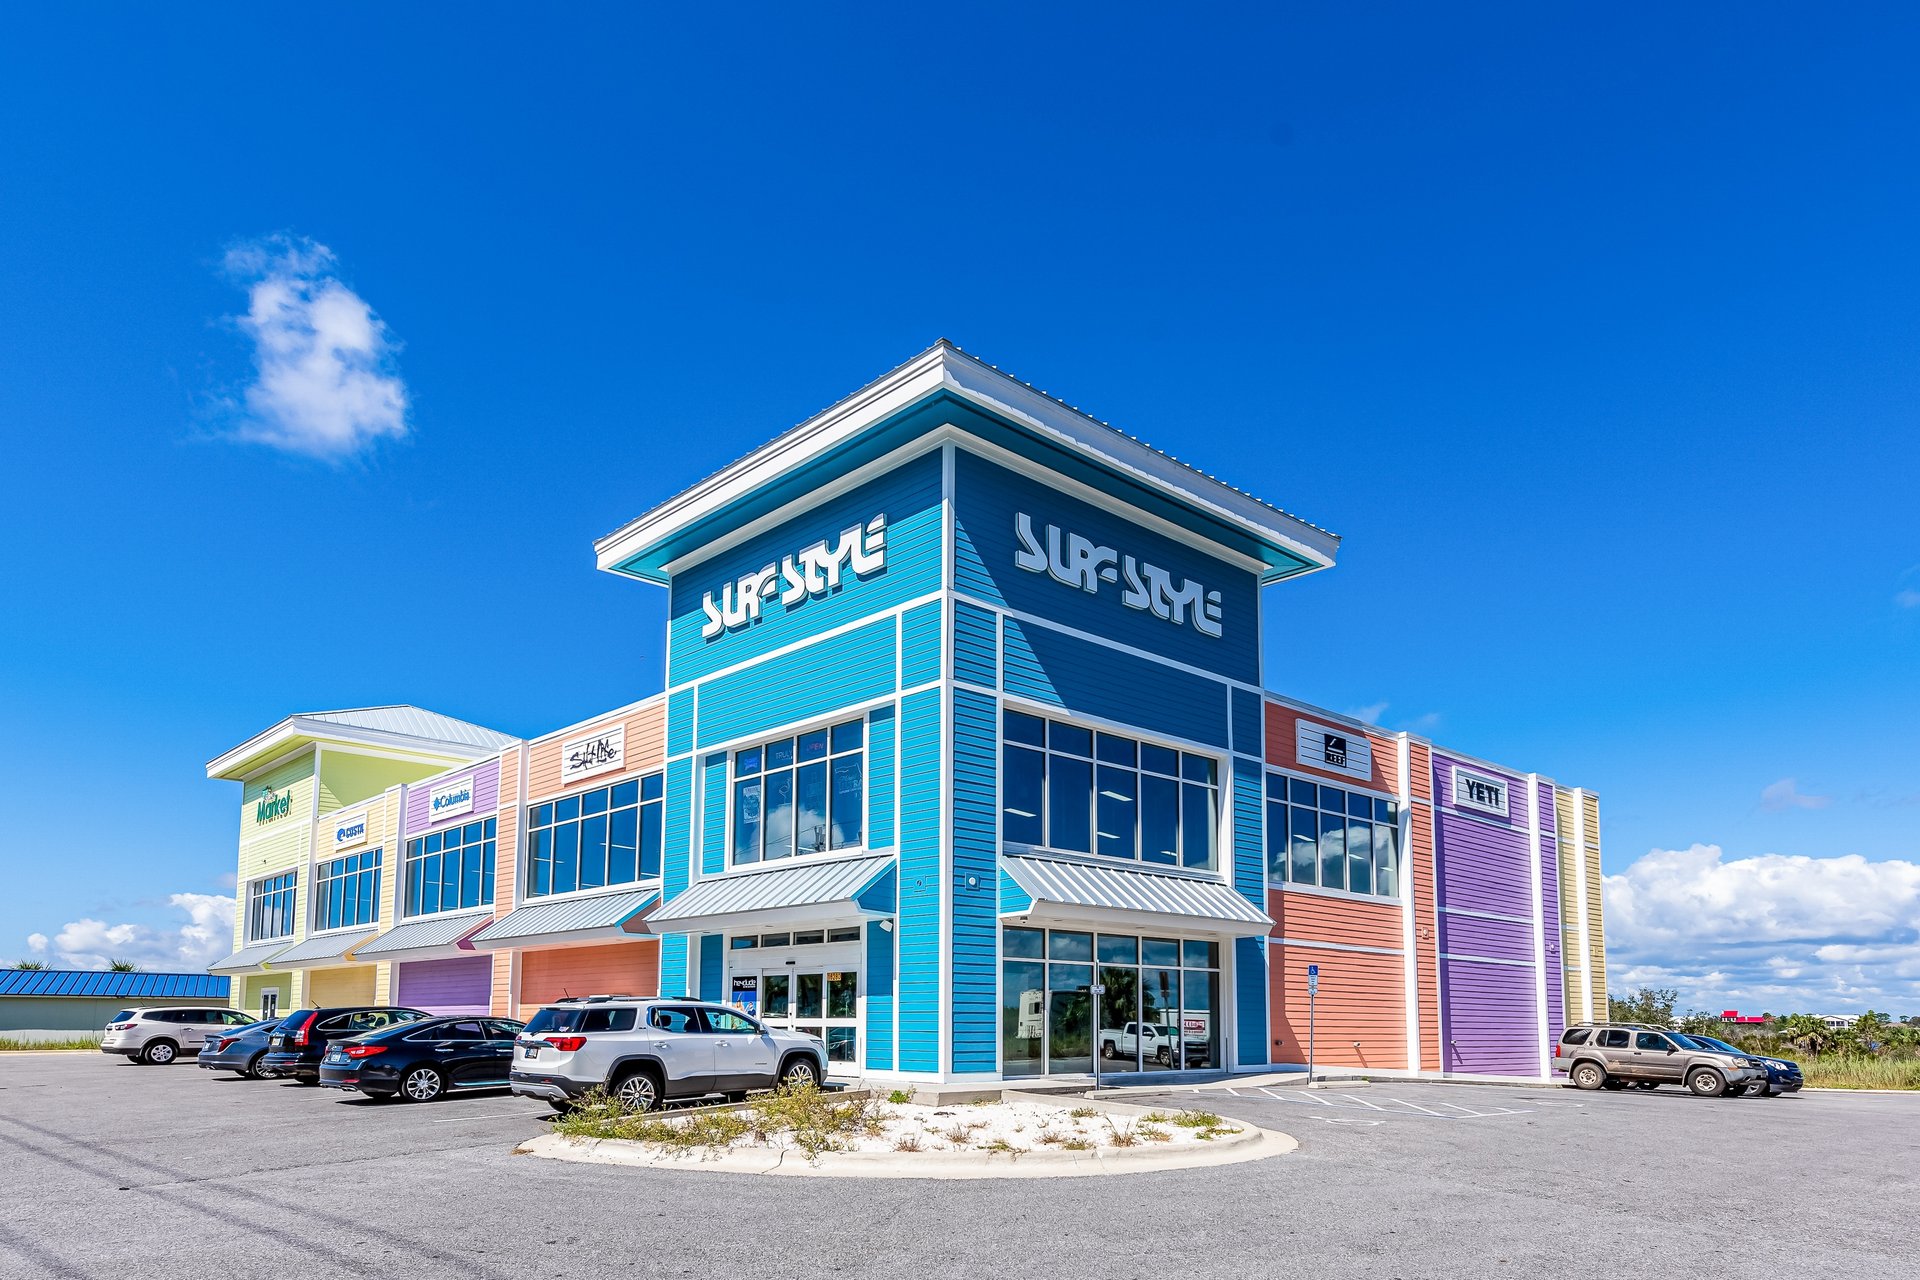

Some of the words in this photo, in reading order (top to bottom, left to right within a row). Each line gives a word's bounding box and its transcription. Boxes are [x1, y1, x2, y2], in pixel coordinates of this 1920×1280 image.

[440, 789, 470, 808] Columbia
[1465, 778, 1500, 806] YETI
[256, 790, 292, 823] Market
[346, 823, 365, 839] COSTA
